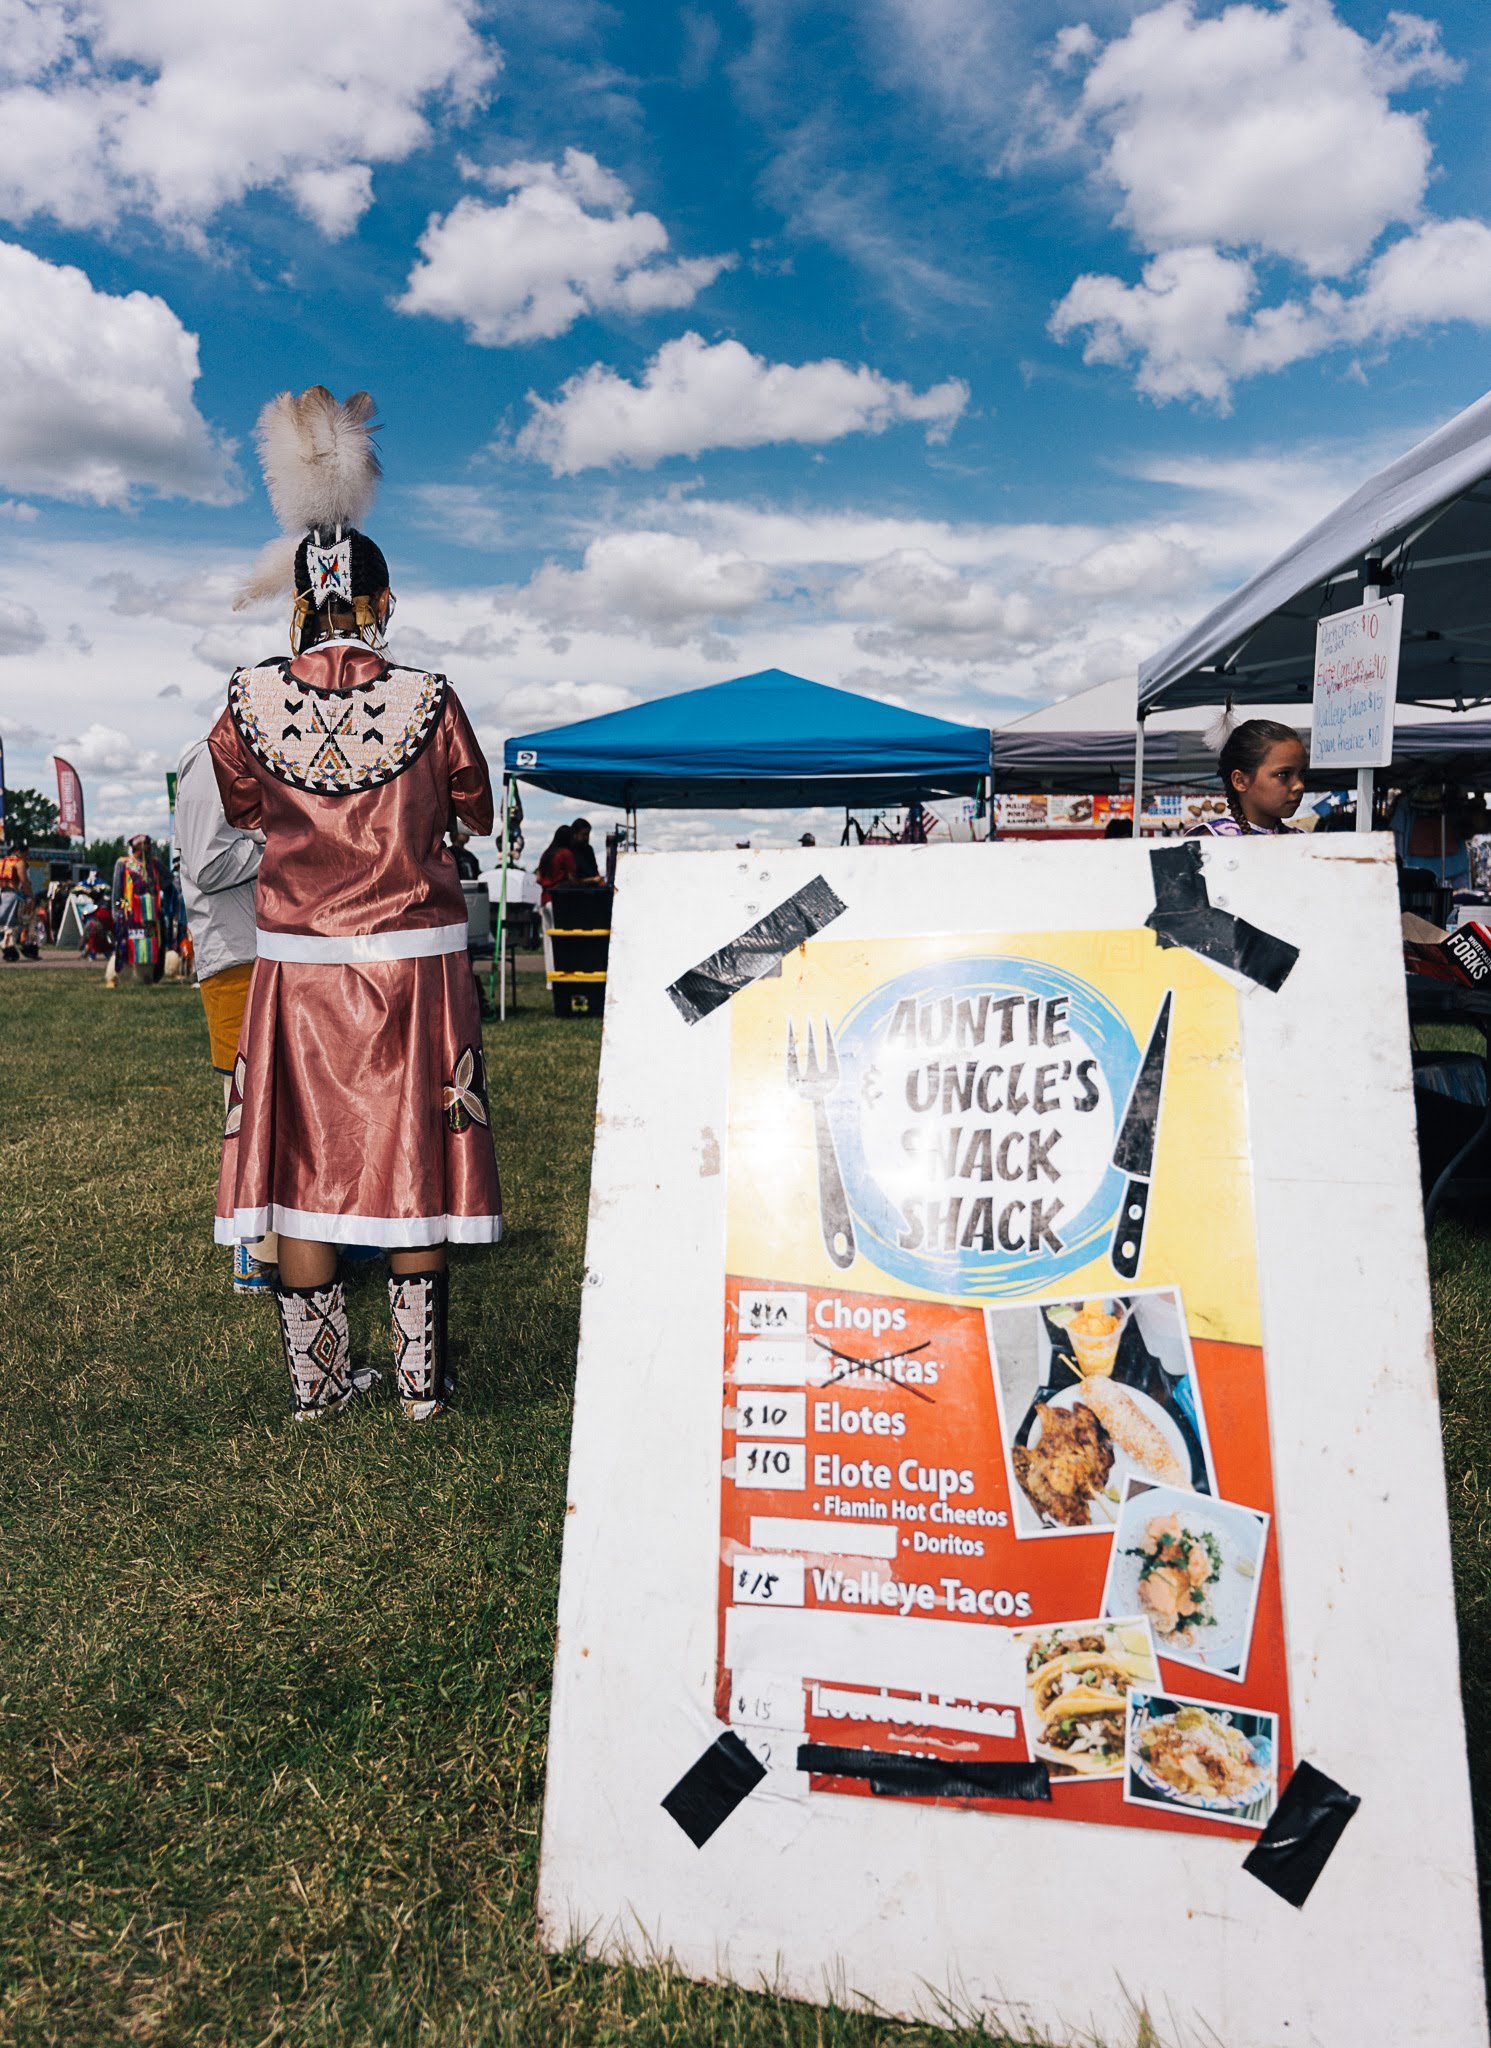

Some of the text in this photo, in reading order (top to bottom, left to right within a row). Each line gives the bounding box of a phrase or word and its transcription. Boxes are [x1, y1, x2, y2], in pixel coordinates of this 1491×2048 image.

[1362, 613, 1379, 639] $10
[1447, 933, 1489, 980] FORKS
[1468, 935, 1483, 953] WHITE
[885, 992, 1072, 1049] AUNTIE
[905, 1058, 1100, 1116] UNCLE'S
[898, 1195, 1065, 1254] SHACK
[813, 1298, 908, 1338] Chops
[743, 1405, 788, 1428] $10
[813, 1400, 907, 1436] Elotes
[747, 1448, 791, 1474] $10
[813, 1453, 975, 1500] Elote Cups
[824, 1495, 1008, 1527] Flamin Hot Cheetos
[913, 1530, 985, 1557] Doritos
[739, 1570, 779, 1599] $15
[811, 1568, 1032, 1618] Walleye Tacos
